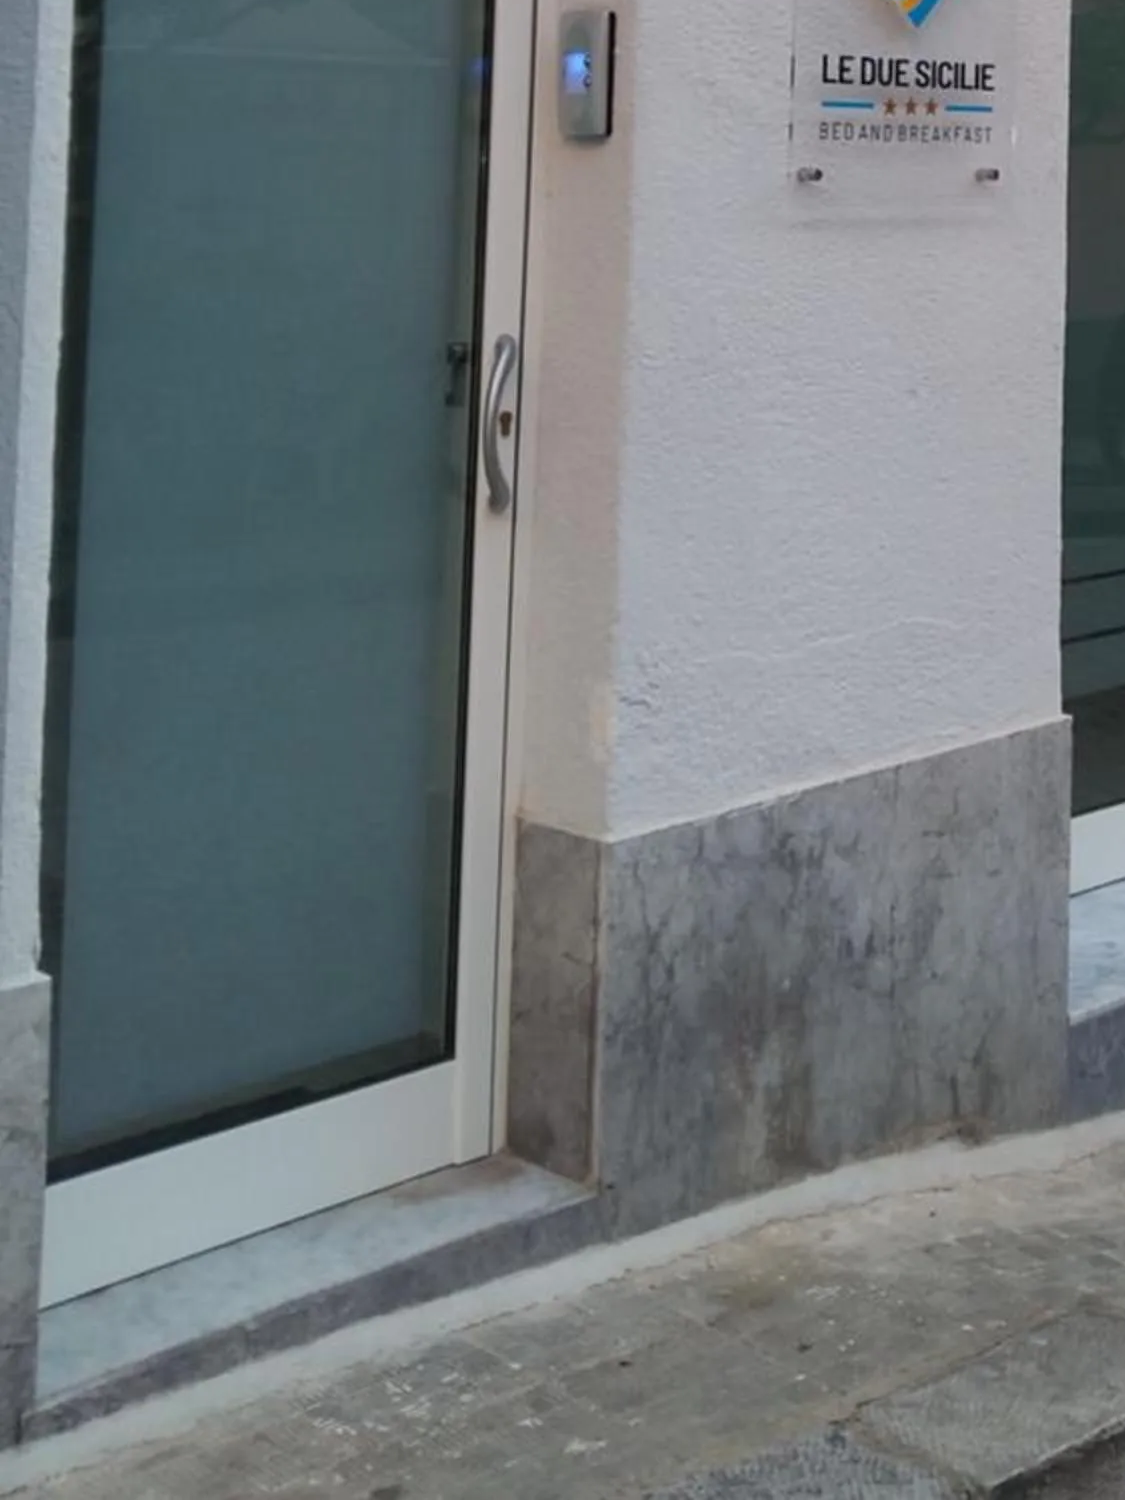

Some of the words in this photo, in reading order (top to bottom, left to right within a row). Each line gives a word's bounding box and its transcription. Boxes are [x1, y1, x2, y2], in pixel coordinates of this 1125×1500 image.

[821, 53, 855, 85] LE
[860, 56, 909, 88] DUE
[914, 59, 996, 92] SICILIE
[818, 121, 855, 142] BED
[858, 123, 894, 143] AND
[897, 123, 993, 145] BREAKFAST
